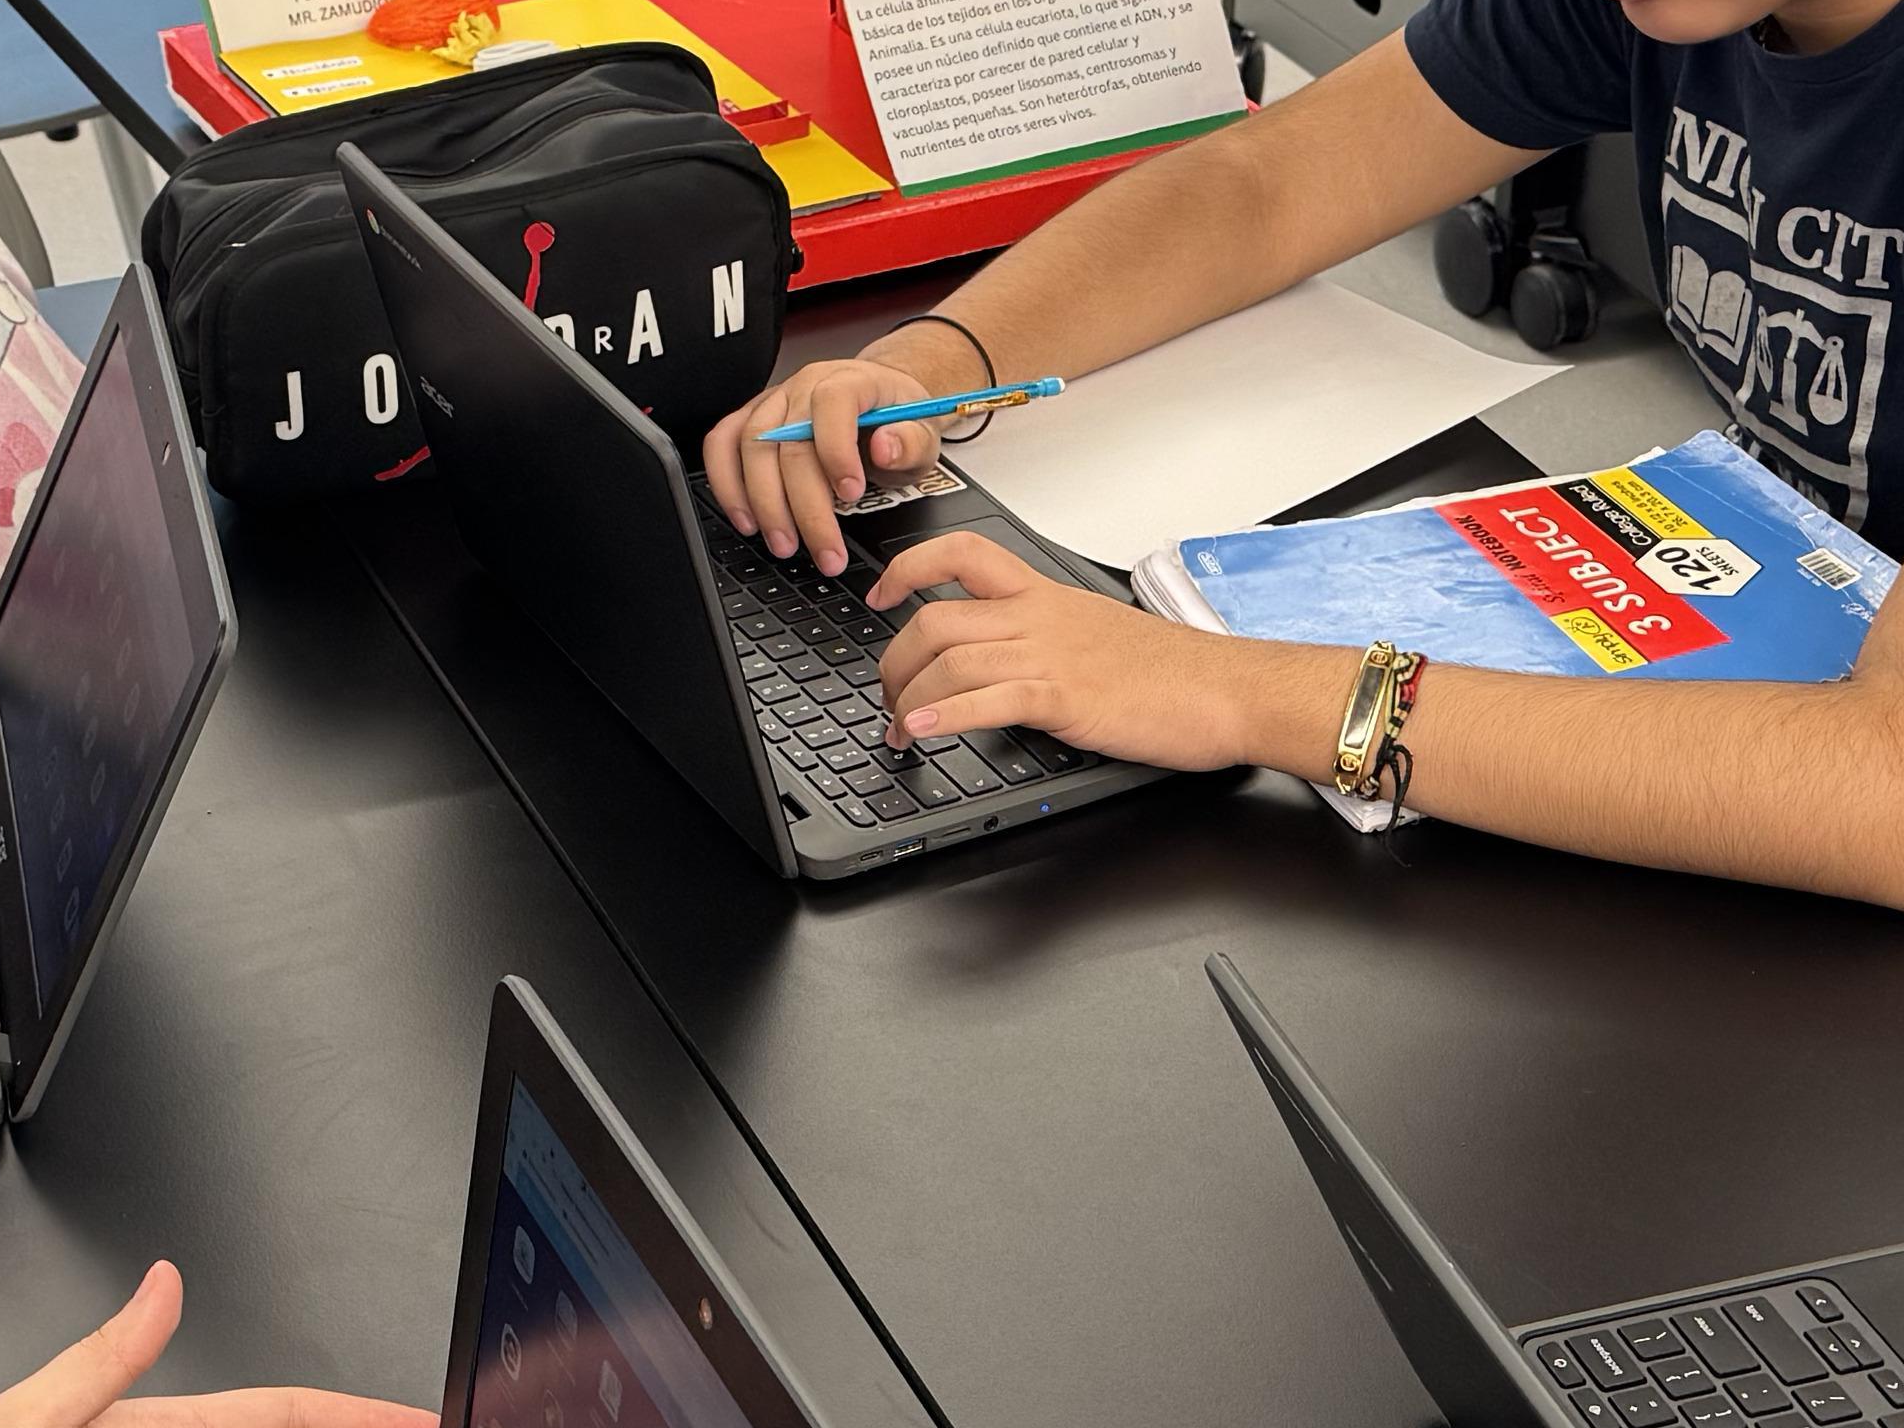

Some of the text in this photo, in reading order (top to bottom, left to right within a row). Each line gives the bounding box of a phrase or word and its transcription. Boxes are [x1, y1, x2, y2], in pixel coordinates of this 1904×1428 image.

[289, 11, 317, 27] MR.
[856, 9, 874, 22] La
[875, 0, 915, 18] célula
[861, 24, 905, 42] básica
[906, 19, 924, 32] de
[924, 15, 946, 28] los
[947, 5, 992, 24] tejidos
[993, 1, 1011, 13] en
[869, 40, 929, 62] Animalia.
[929, 35, 947, 49] Es
[947, 30, 974, 45] una
[975, 19, 1014, 38] célula
[1015, 8, 1079, 29] eucariota,
[1079, 3, 1093, 16] lo
[1095, 0, 1119, 14] que
[873, 2, 1193, 85] posee un núcleo definido que contiene el ADN, y se
[880, 35, 1140, 101] caracteriza por carecer de pared celular y
[886, 47, 1176, 121] cloroplastos, poseer lisosomas, centrosomas y
[892, 61, 1203, 140] vacuolas pequeñas. Son heterótrofas, obteniendo
[899, 107, 1097, 160] nutrientes de otros seres vivos.
[1454, 514, 1527, 571] NOTEBOOK
[1568, 484, 1653, 546] College Ruled
[1499, 507, 1672, 635] 3 SUBJECT
[1655, 546, 1722, 597] 120
[1695, 546, 1740, 576] SHEETS
[1591, 1337, 1624, 1377] backspace
